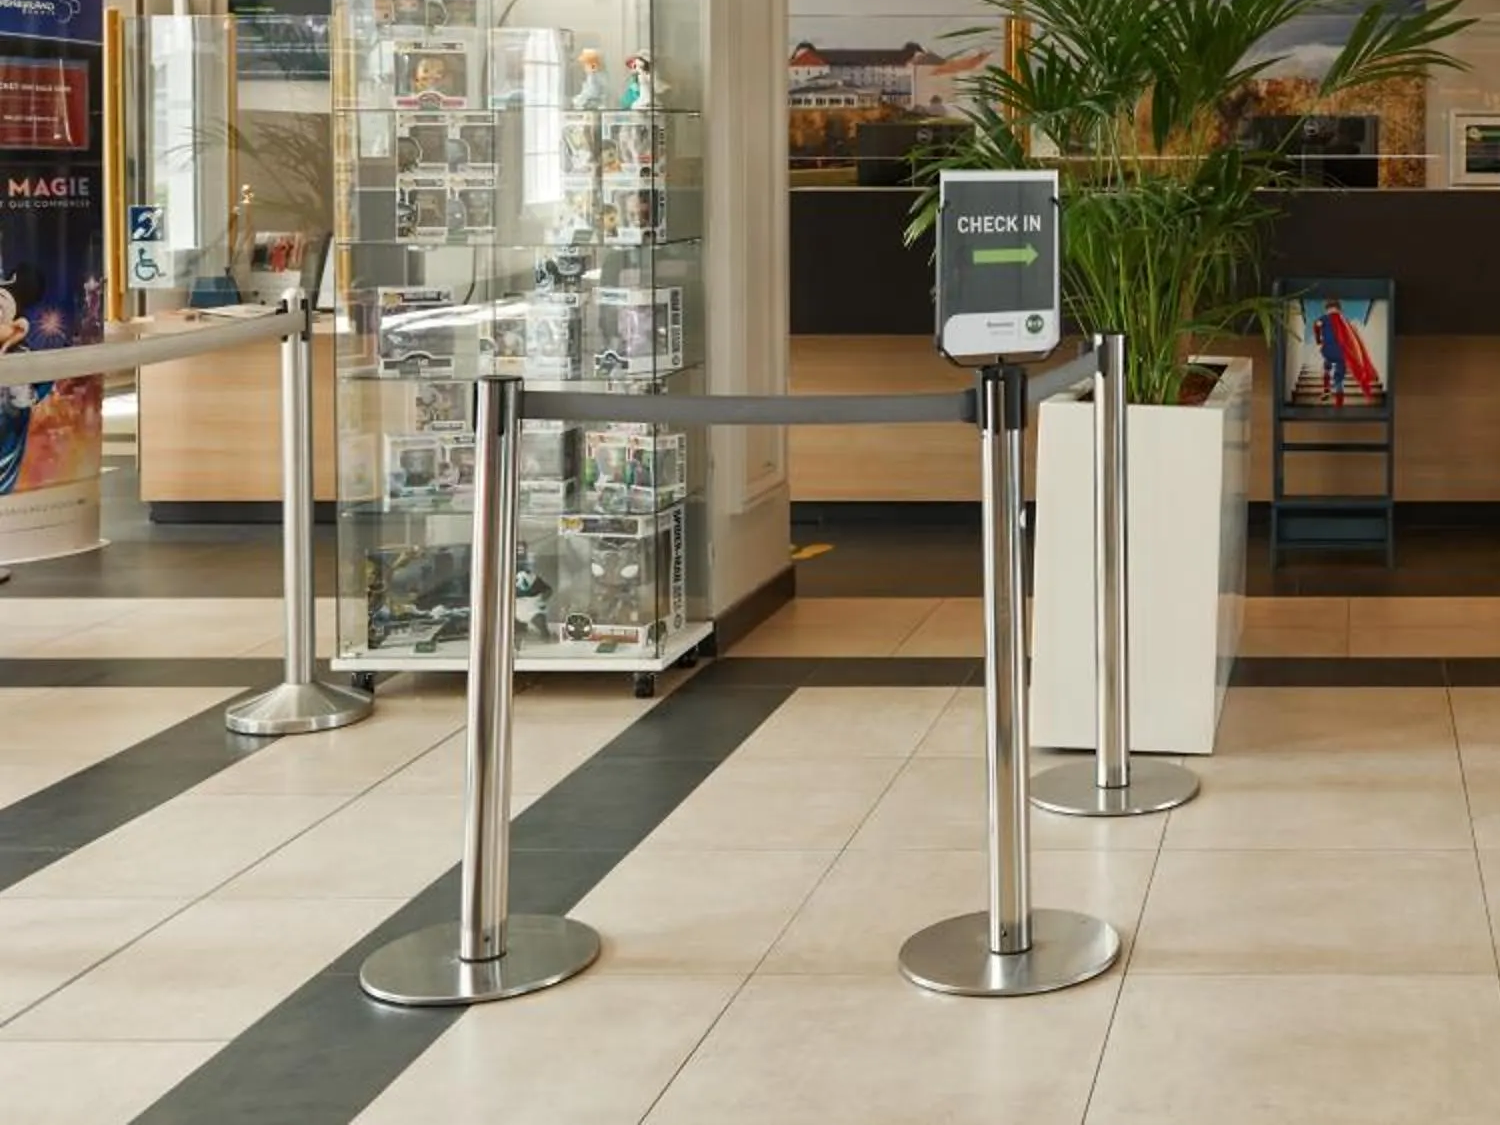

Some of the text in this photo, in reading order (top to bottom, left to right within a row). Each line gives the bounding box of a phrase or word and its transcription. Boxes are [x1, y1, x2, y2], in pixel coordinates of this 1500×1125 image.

[8, 178, 90, 198] MAGIE
[9, 200, 31, 210] QUE
[957, 214, 1041, 234] CHECK IN
